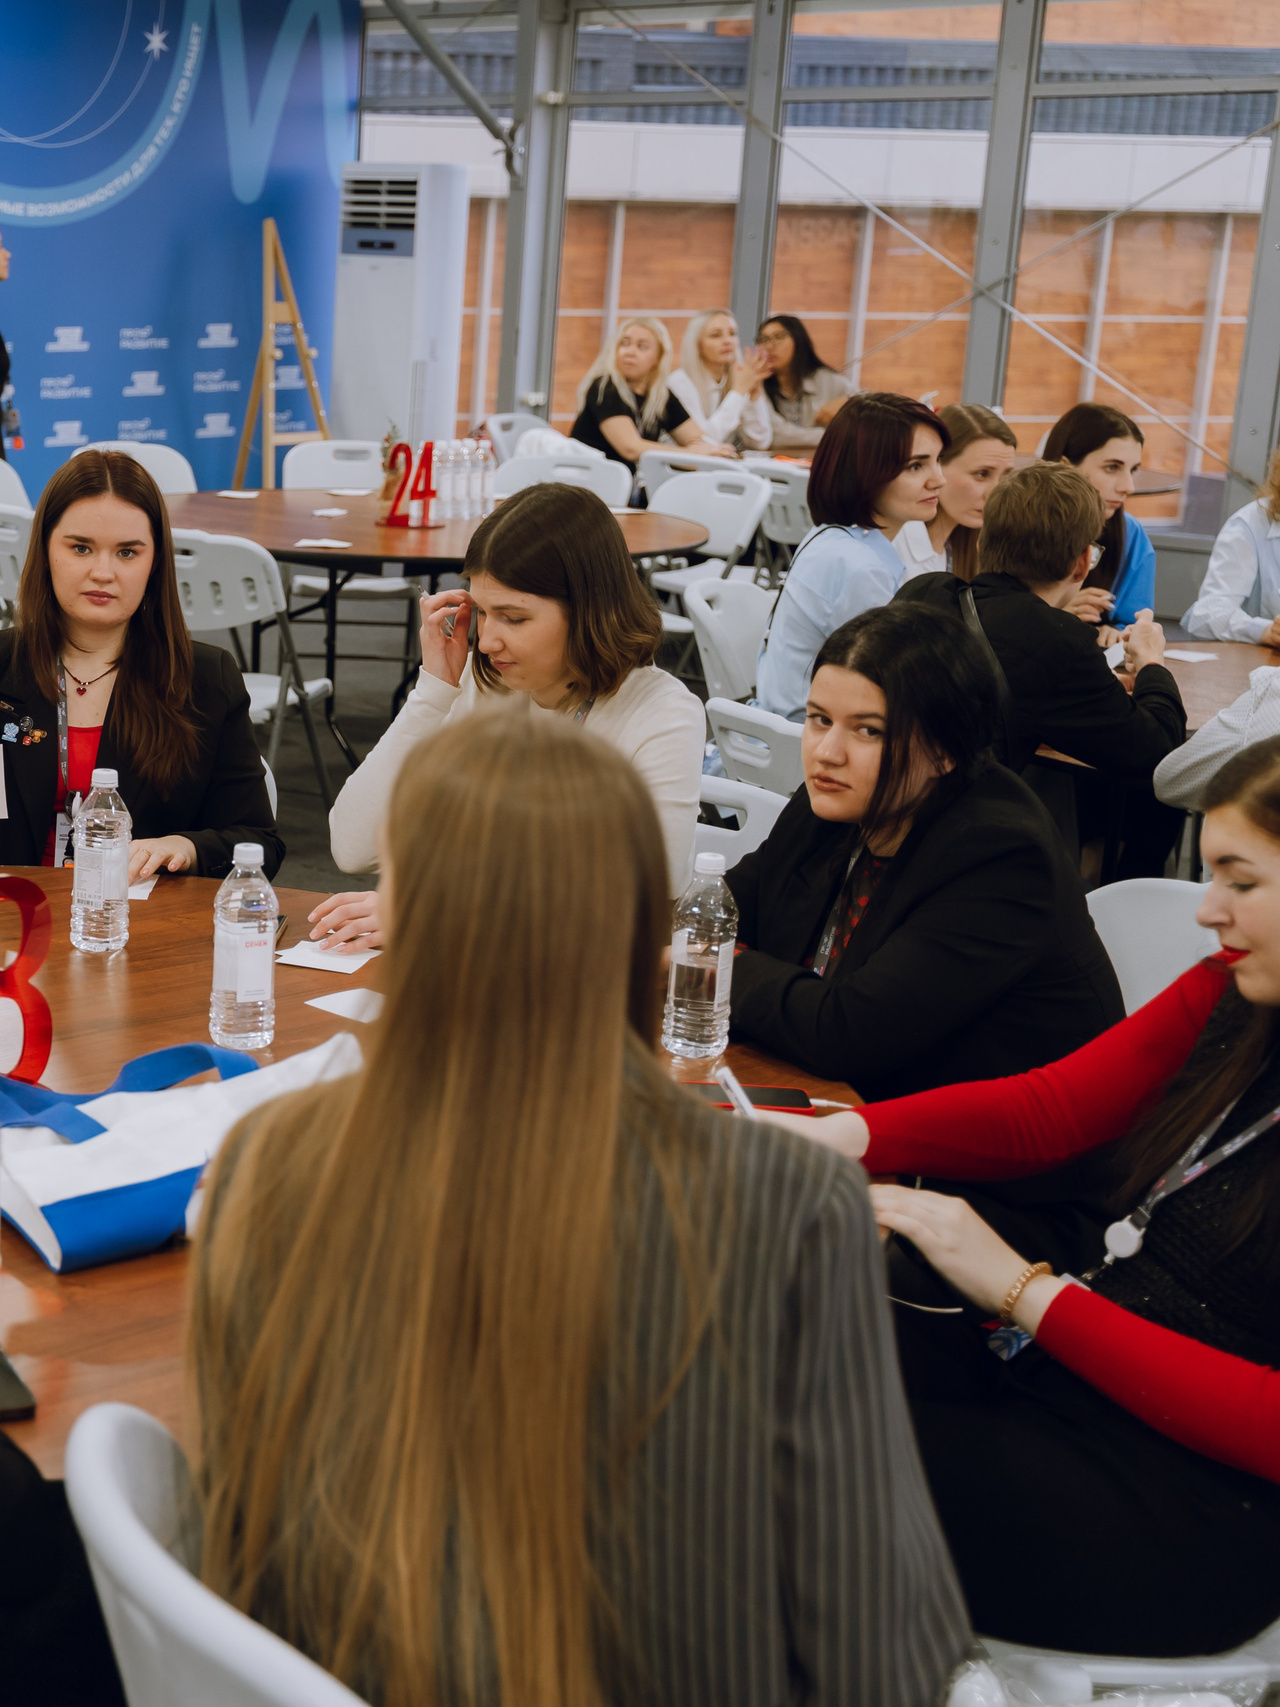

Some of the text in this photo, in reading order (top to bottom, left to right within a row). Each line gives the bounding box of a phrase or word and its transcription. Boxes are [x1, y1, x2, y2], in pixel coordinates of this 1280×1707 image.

[26, 170, 132, 217] ВОЗМОЖНОСТИ
[130, 143, 158, 180] ДЛЯ
[171, 77, 191, 114] КТО
[182, 21, 202, 79] ИЩЕТ
[386, 441, 437, 528] 24
